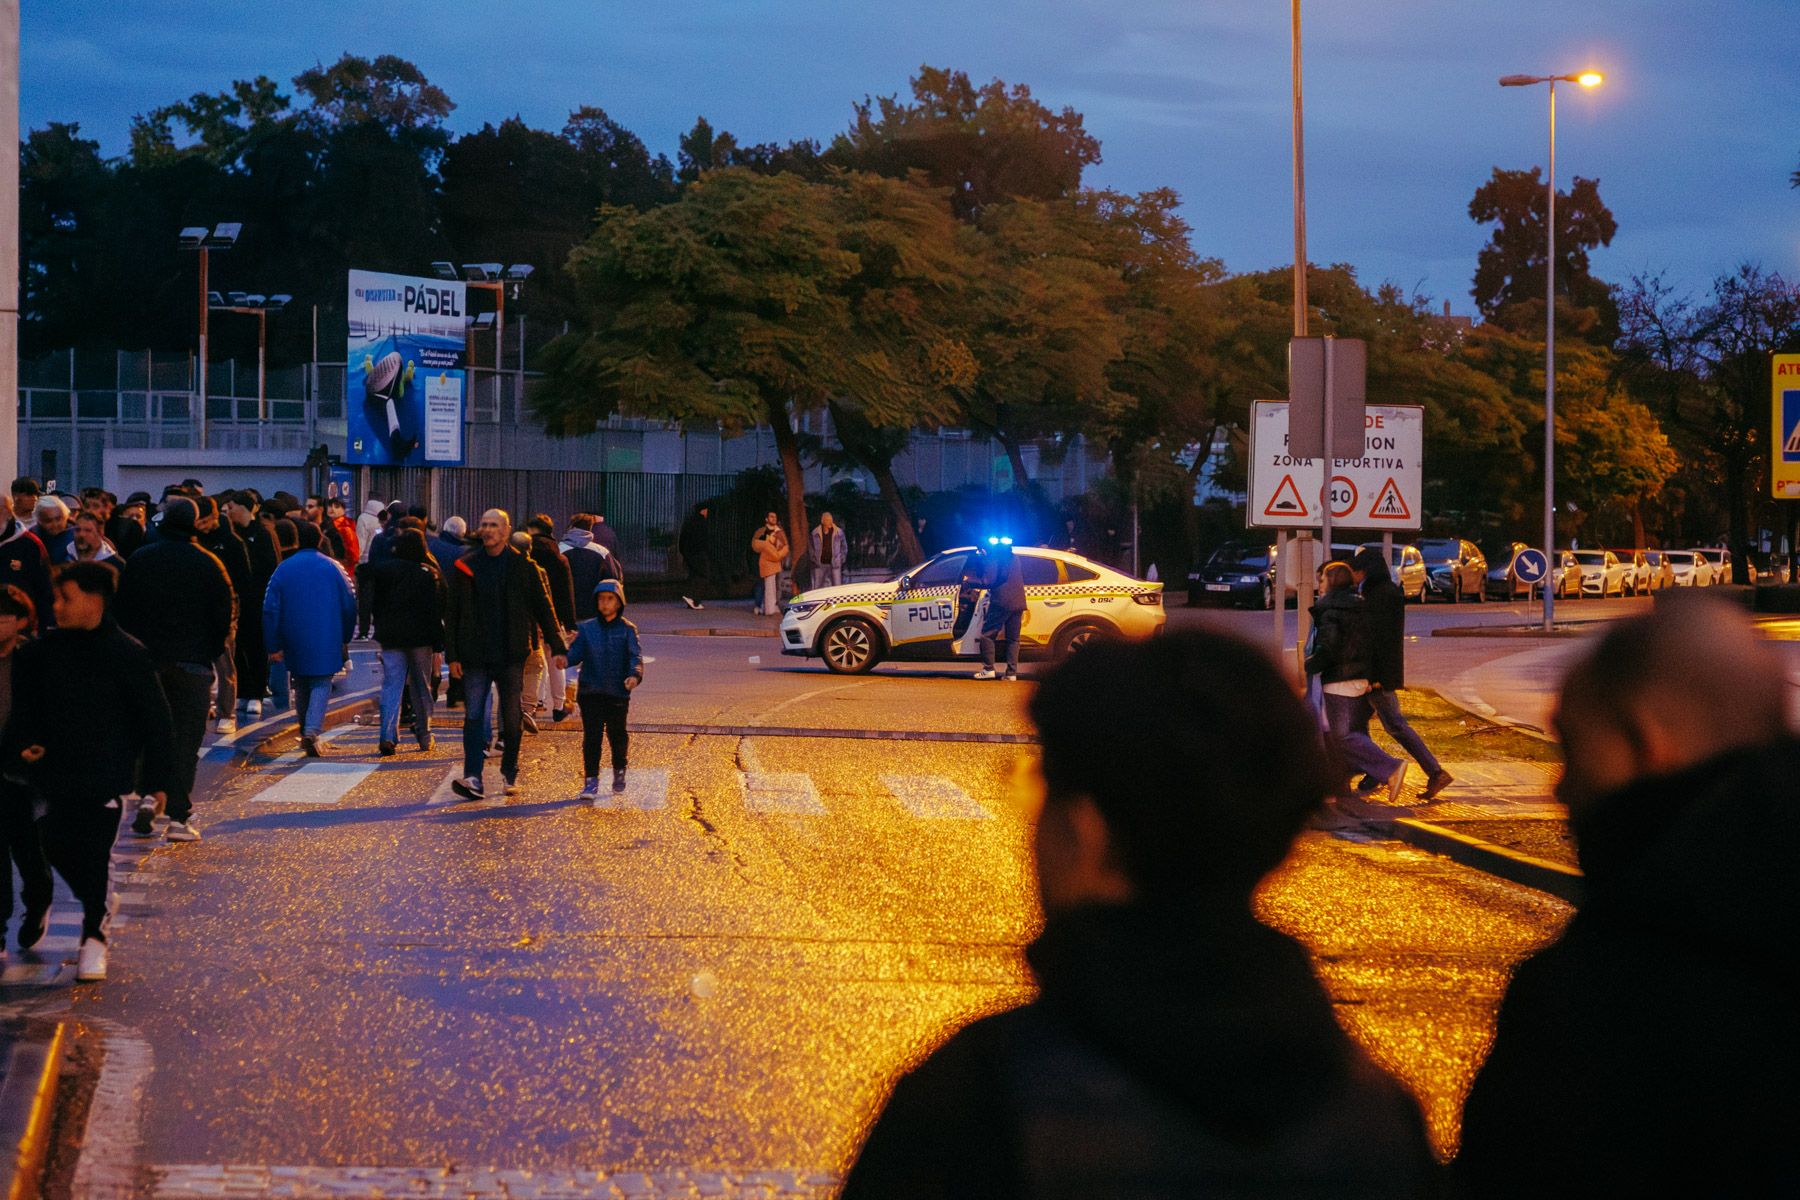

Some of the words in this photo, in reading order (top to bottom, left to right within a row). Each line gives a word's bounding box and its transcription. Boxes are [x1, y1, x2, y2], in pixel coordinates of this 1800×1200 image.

[404, 284, 461, 317] PÁDEL
[1273, 455, 1313, 467] ZONA
[1334, 458, 1404, 470] EPORTIVA
